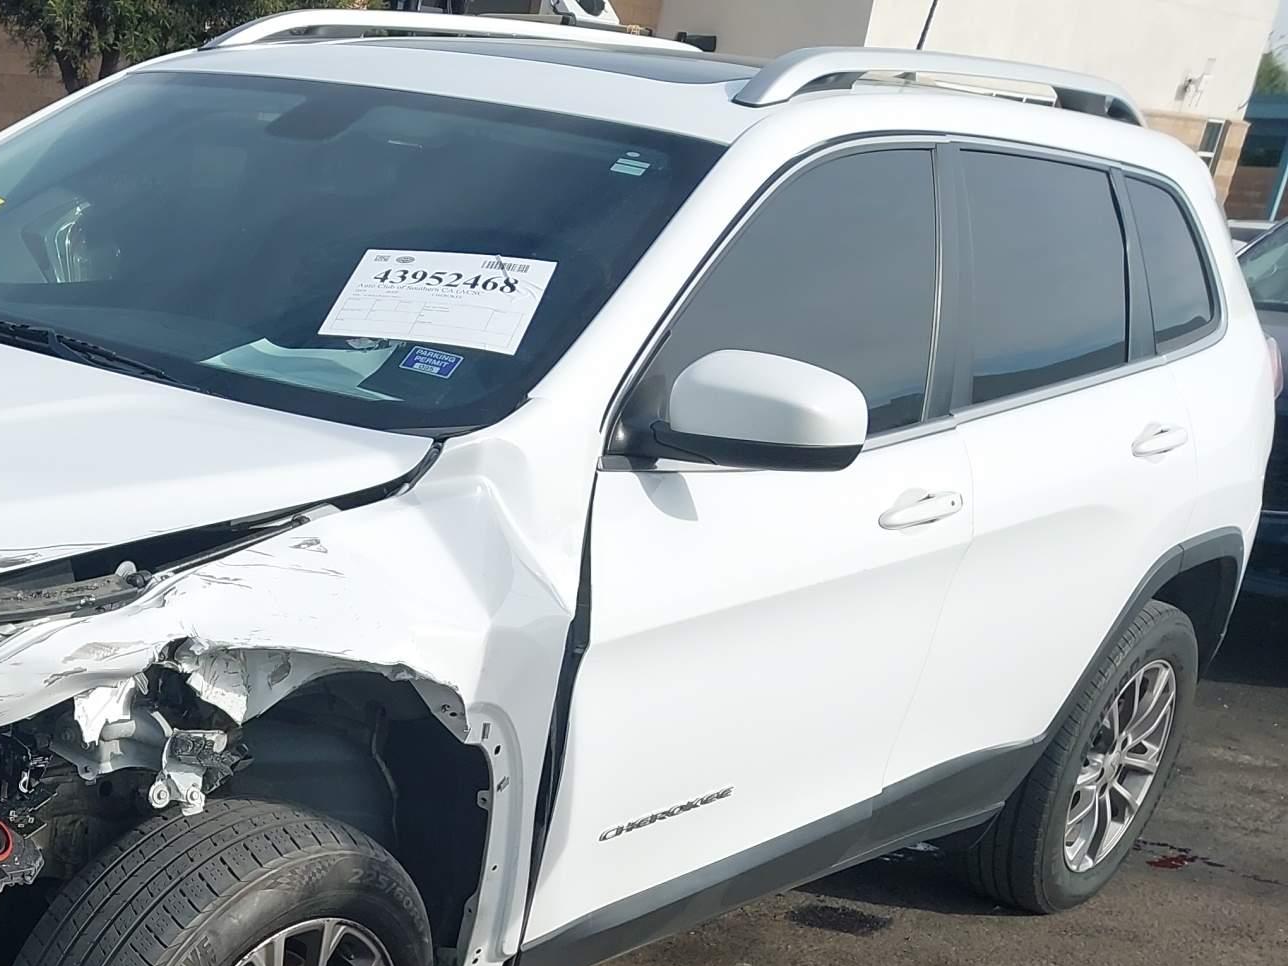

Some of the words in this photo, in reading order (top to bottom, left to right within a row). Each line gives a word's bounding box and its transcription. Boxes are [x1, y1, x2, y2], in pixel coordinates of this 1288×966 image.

[373, 268, 519, 294] 43952468
[414, 355, 450, 368] PERMIT
[415, 349, 456, 363] PARKING
[599, 786, 734, 842] CHEROKEE
